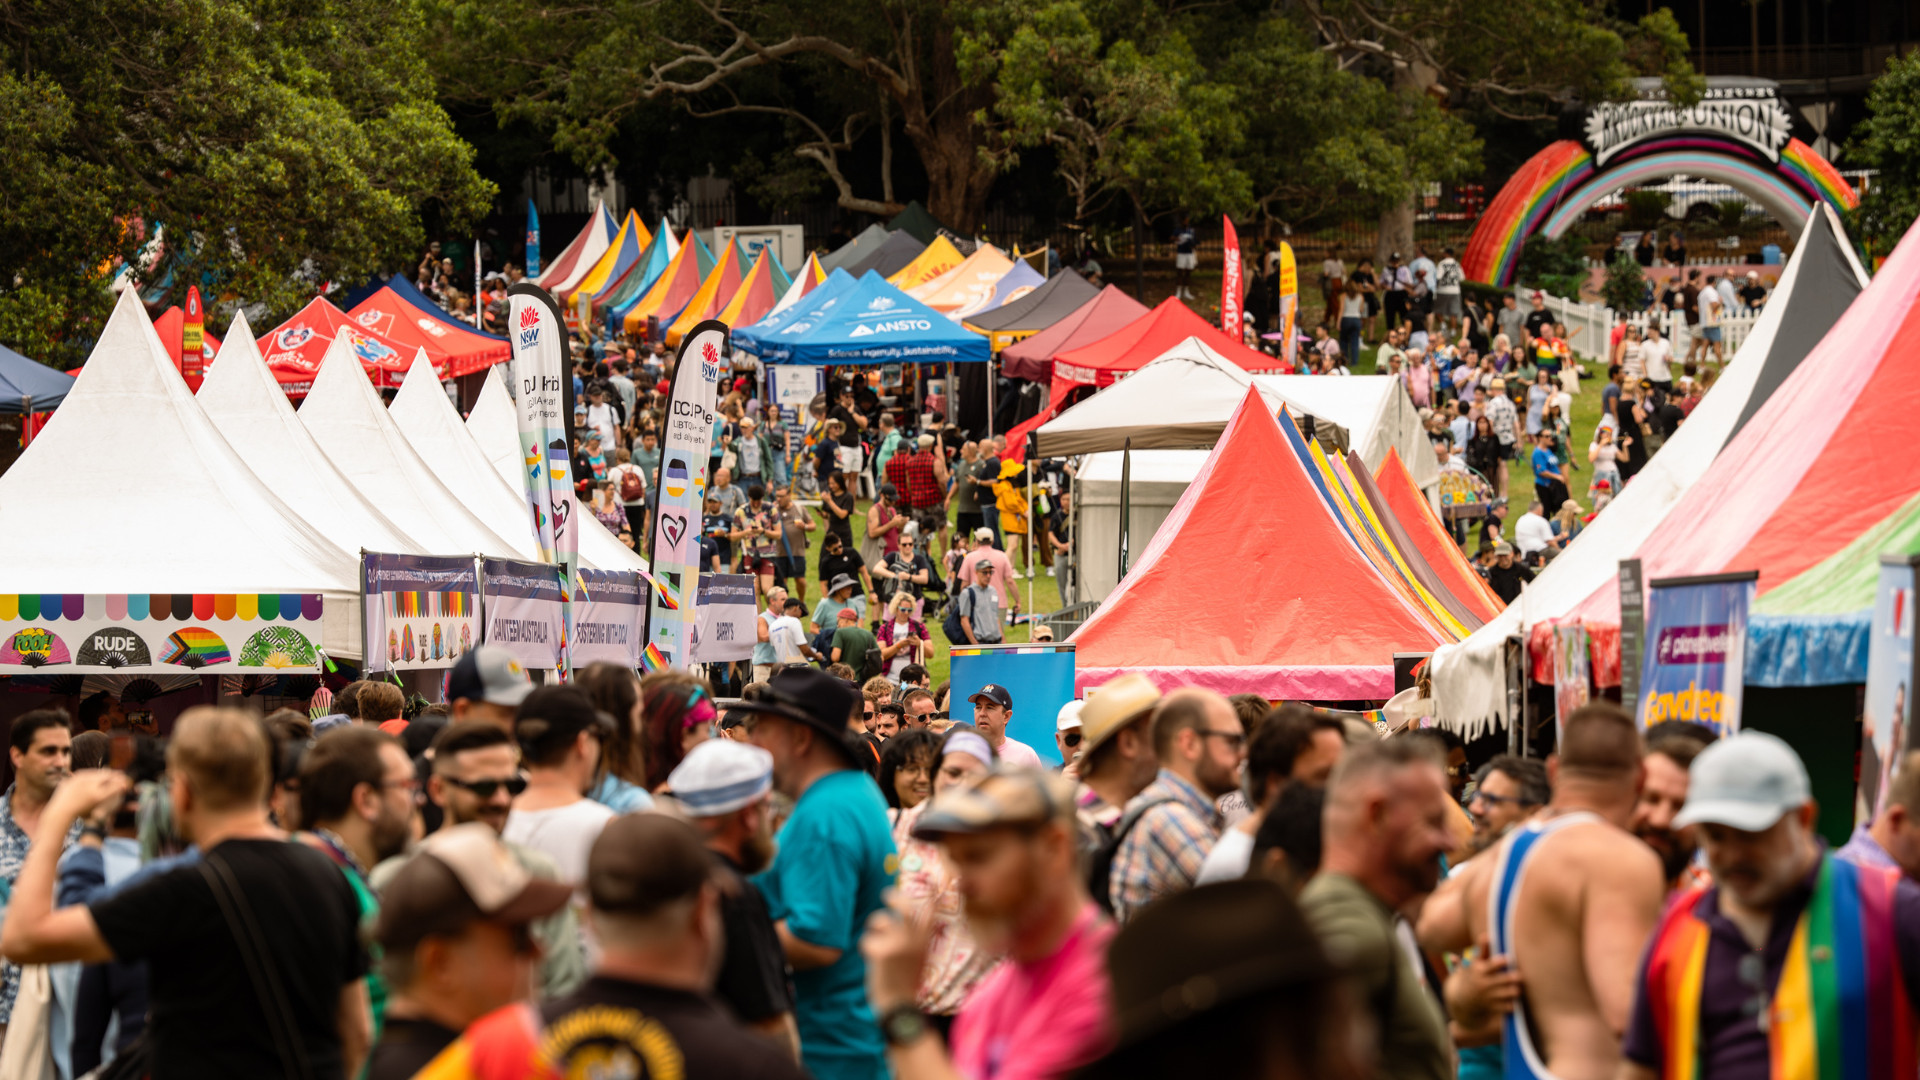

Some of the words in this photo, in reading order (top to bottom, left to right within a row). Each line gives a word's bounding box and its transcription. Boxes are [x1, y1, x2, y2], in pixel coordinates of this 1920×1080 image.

[1694, 103, 1774, 149] UNION
[875, 319, 931, 333] ANSTO
[493, 618, 521, 642] CANTEEN
[521, 619, 548, 643] AUSTRALIA
[716, 622, 734, 641] BARRY'S
[13, 634, 56, 651] POOF!
[94, 636, 136, 651] RUDE
